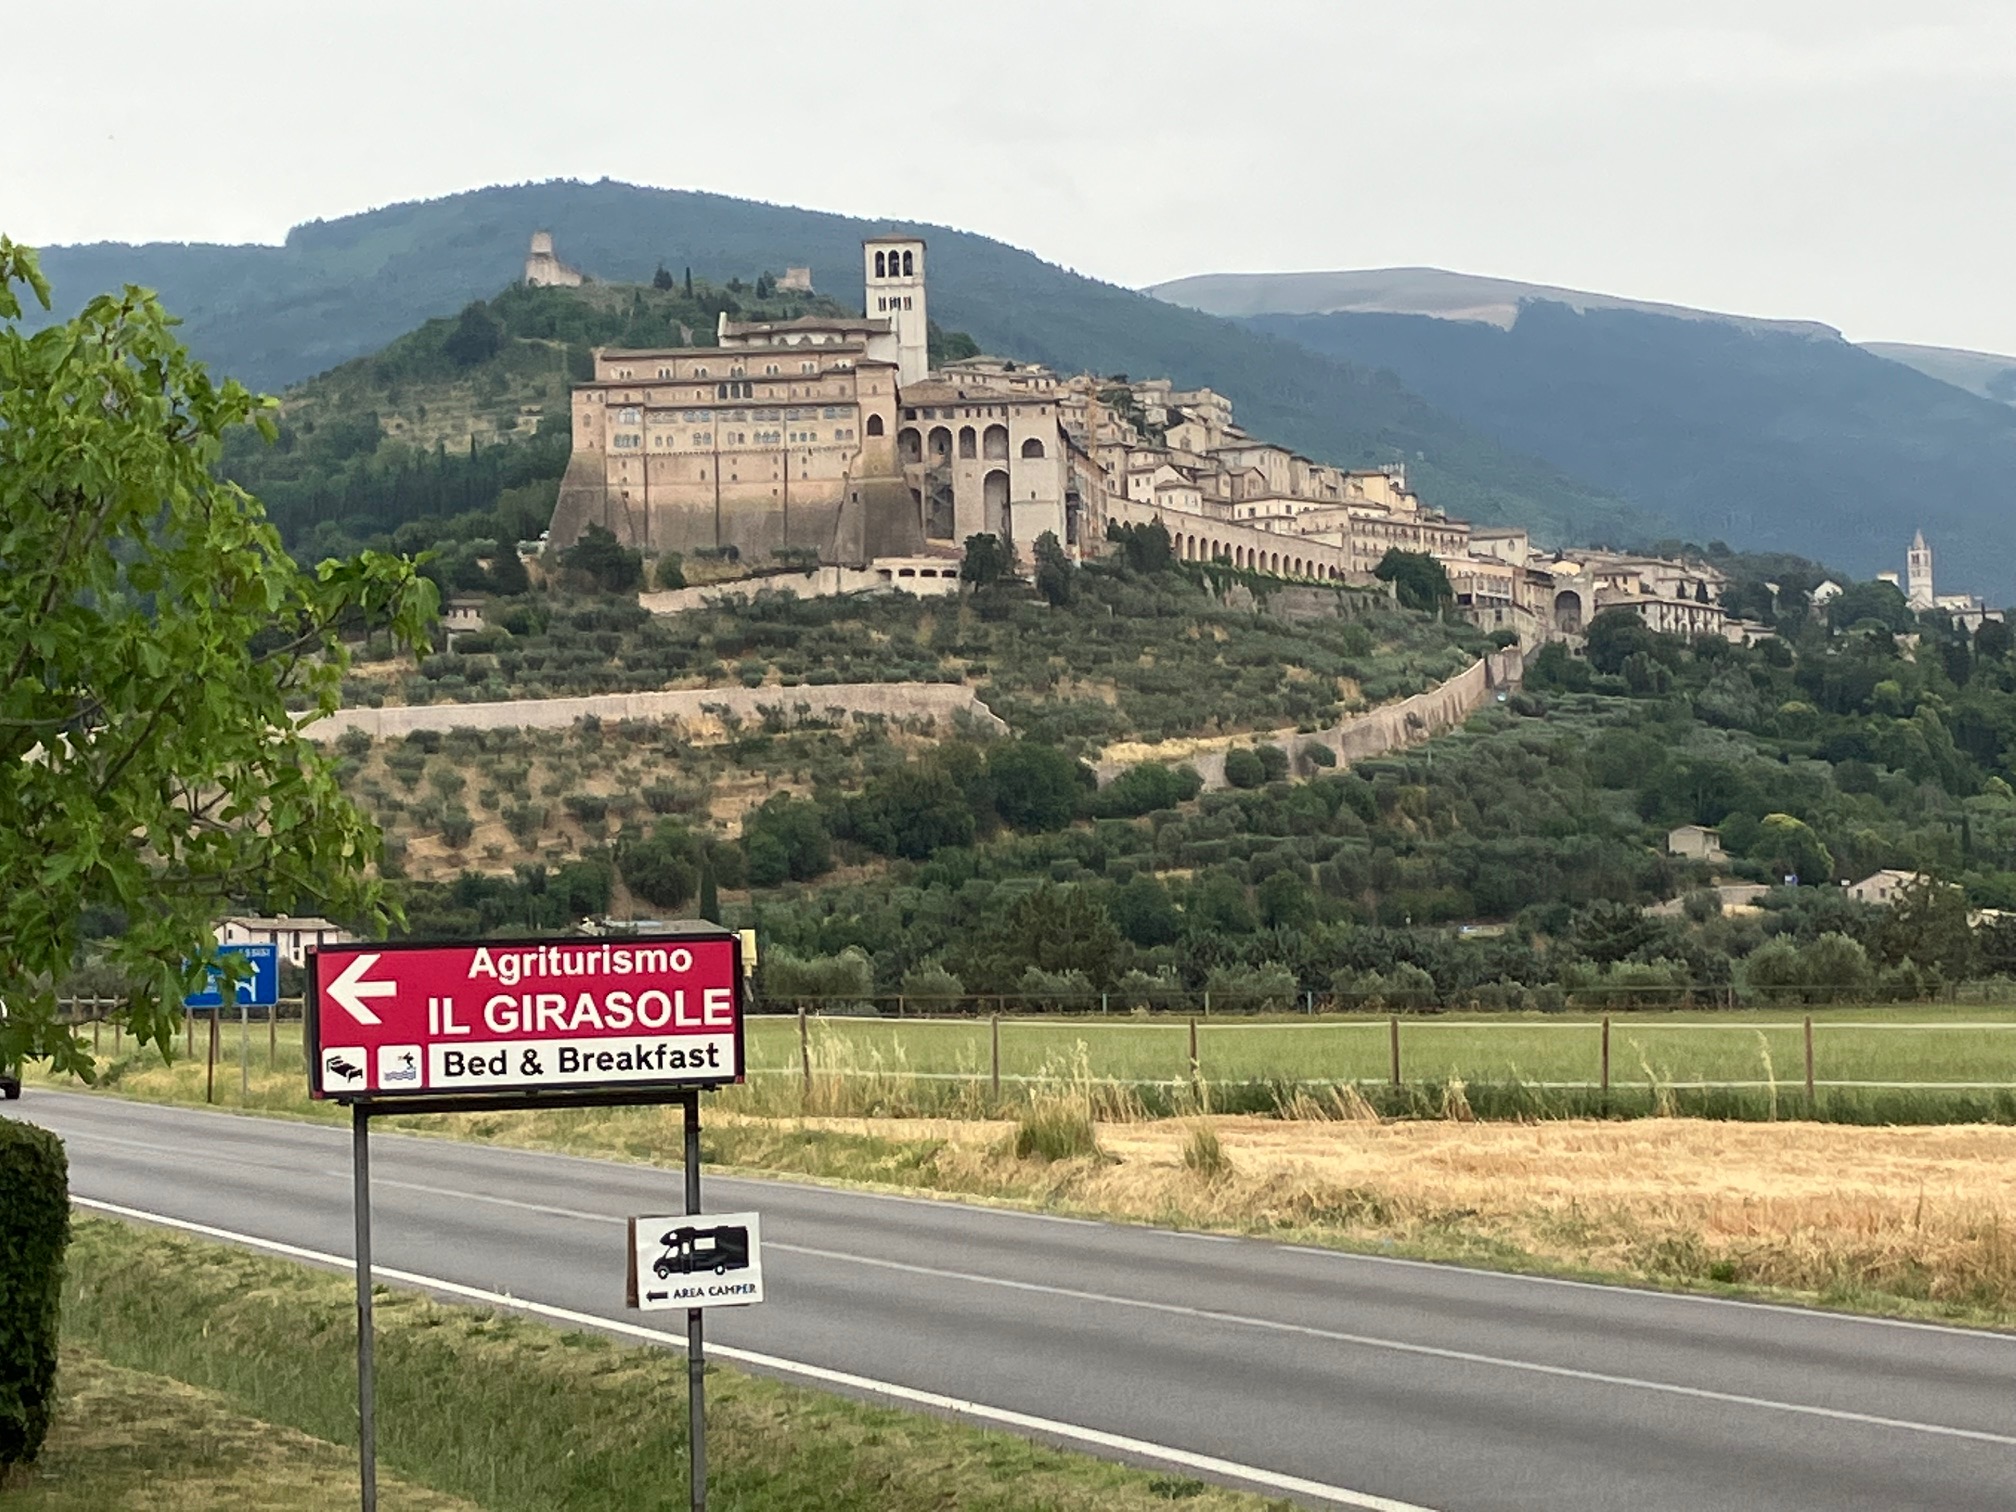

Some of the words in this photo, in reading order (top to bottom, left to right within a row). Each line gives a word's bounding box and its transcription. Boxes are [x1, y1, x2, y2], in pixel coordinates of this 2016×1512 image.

[467, 944, 693, 986] Agriturismo
[428, 997, 471, 1035] IL
[483, 988, 733, 1034] GIRASOLE
[443, 1049, 508, 1077] Bed
[519, 1049, 544, 1076] &
[558, 1042, 720, 1073] Breakfast
[673, 1286, 705, 1299] AREA
[708, 1283, 756, 1297] CAMPER
